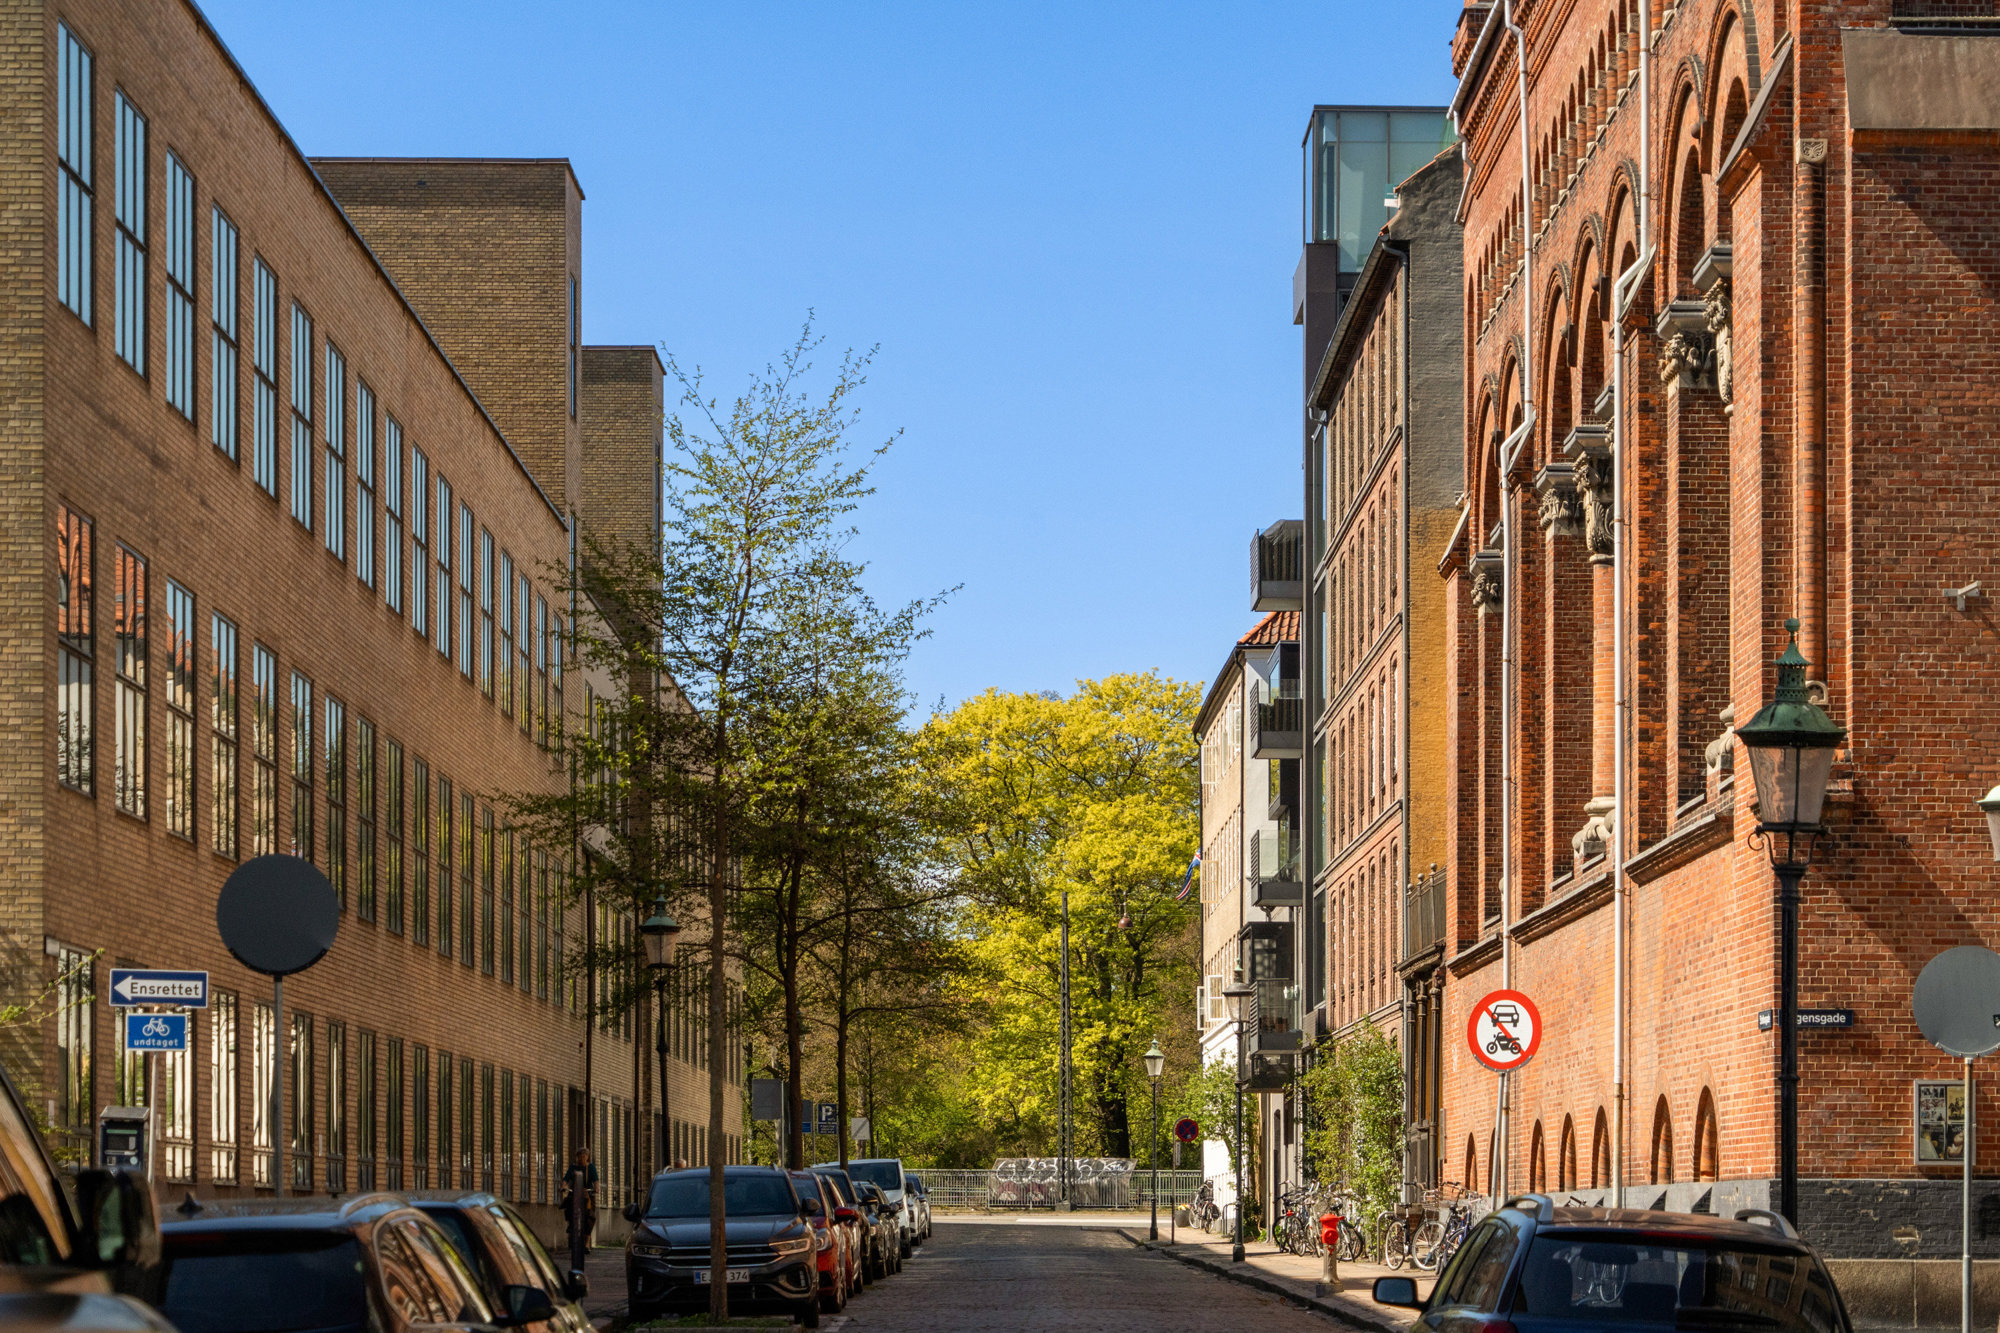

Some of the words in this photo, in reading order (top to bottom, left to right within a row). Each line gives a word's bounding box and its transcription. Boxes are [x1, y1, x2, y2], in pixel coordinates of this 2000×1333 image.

[130, 982, 199, 996] Ensrettet
[1797, 1013, 1846, 1025] gensgade
[134, 1038, 179, 1048] undtaget
[822, 1105, 832, 1121] P
[730, 1271, 748, 1281] 374
